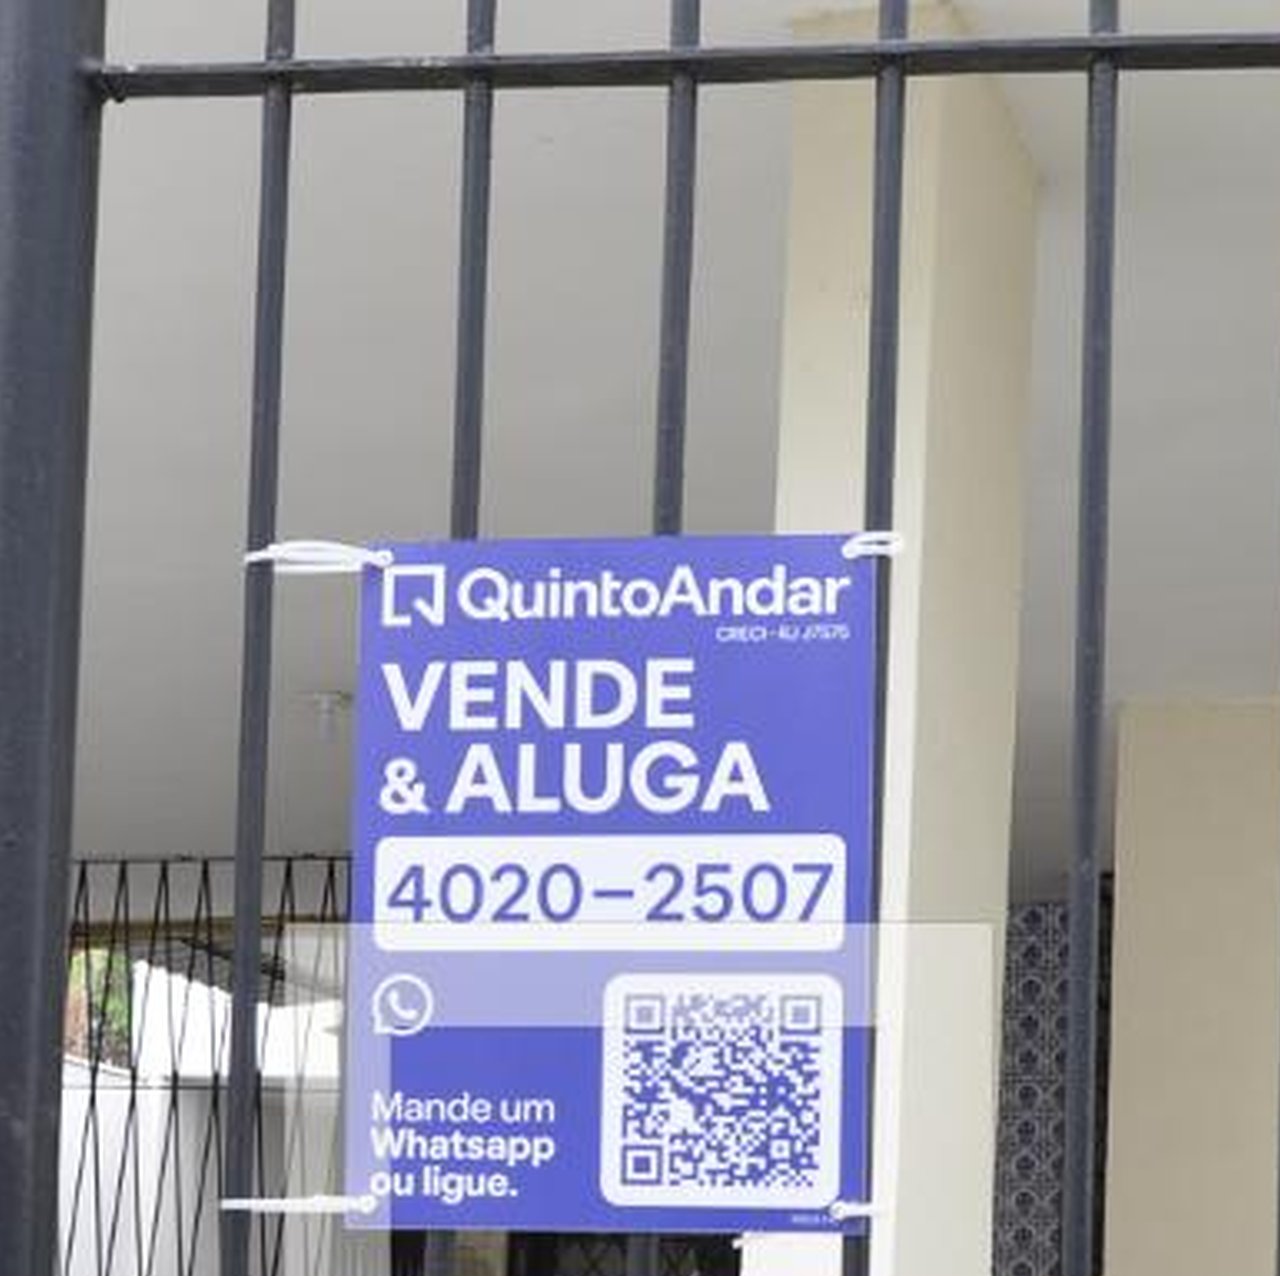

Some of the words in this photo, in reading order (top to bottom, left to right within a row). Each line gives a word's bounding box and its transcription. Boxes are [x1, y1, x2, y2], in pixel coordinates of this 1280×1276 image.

[456, 564, 851, 622] QuintoAndar
[381, 657, 695, 731] VENDE
[379, 757, 430, 815] &
[443, 740, 771, 814] ALUGA
[386, 862, 834, 924] 4020-2507
[372, 1088, 493, 1123] Mande
[499, 1097, 556, 1123] um
[370, 1126, 557, 1168] Whatsapp
[369, 1171, 416, 1197] ou
[422, 1164, 519, 1205] ligue.
